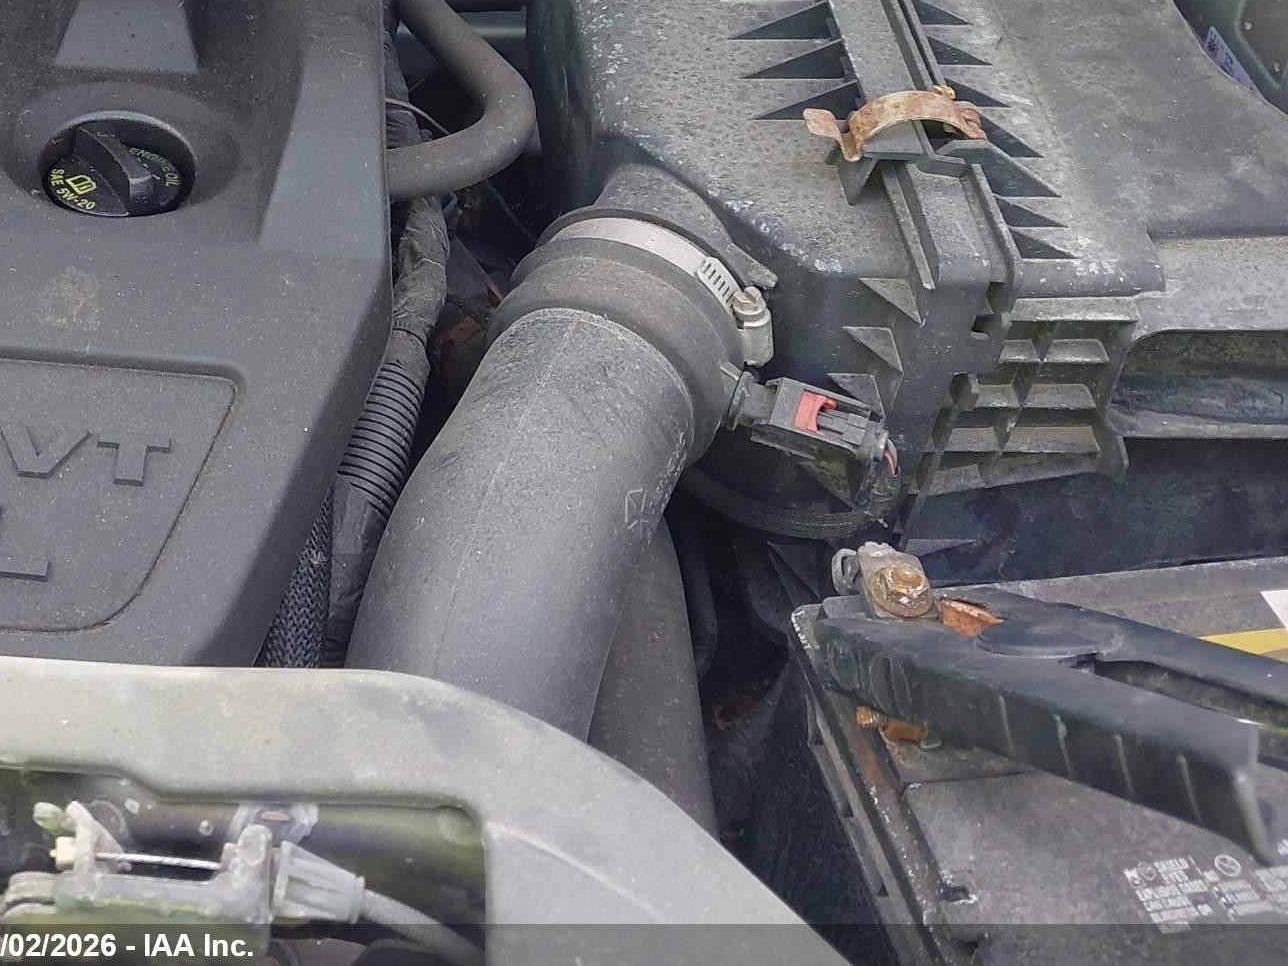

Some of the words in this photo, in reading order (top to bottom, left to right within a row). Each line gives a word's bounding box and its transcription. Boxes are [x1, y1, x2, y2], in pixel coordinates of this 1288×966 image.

[50, 169, 65, 186] SAE
[128, 147, 175, 173] ENGINE
[165, 173, 180, 186] OIL
[56, 188, 96, 210] 5W-20
